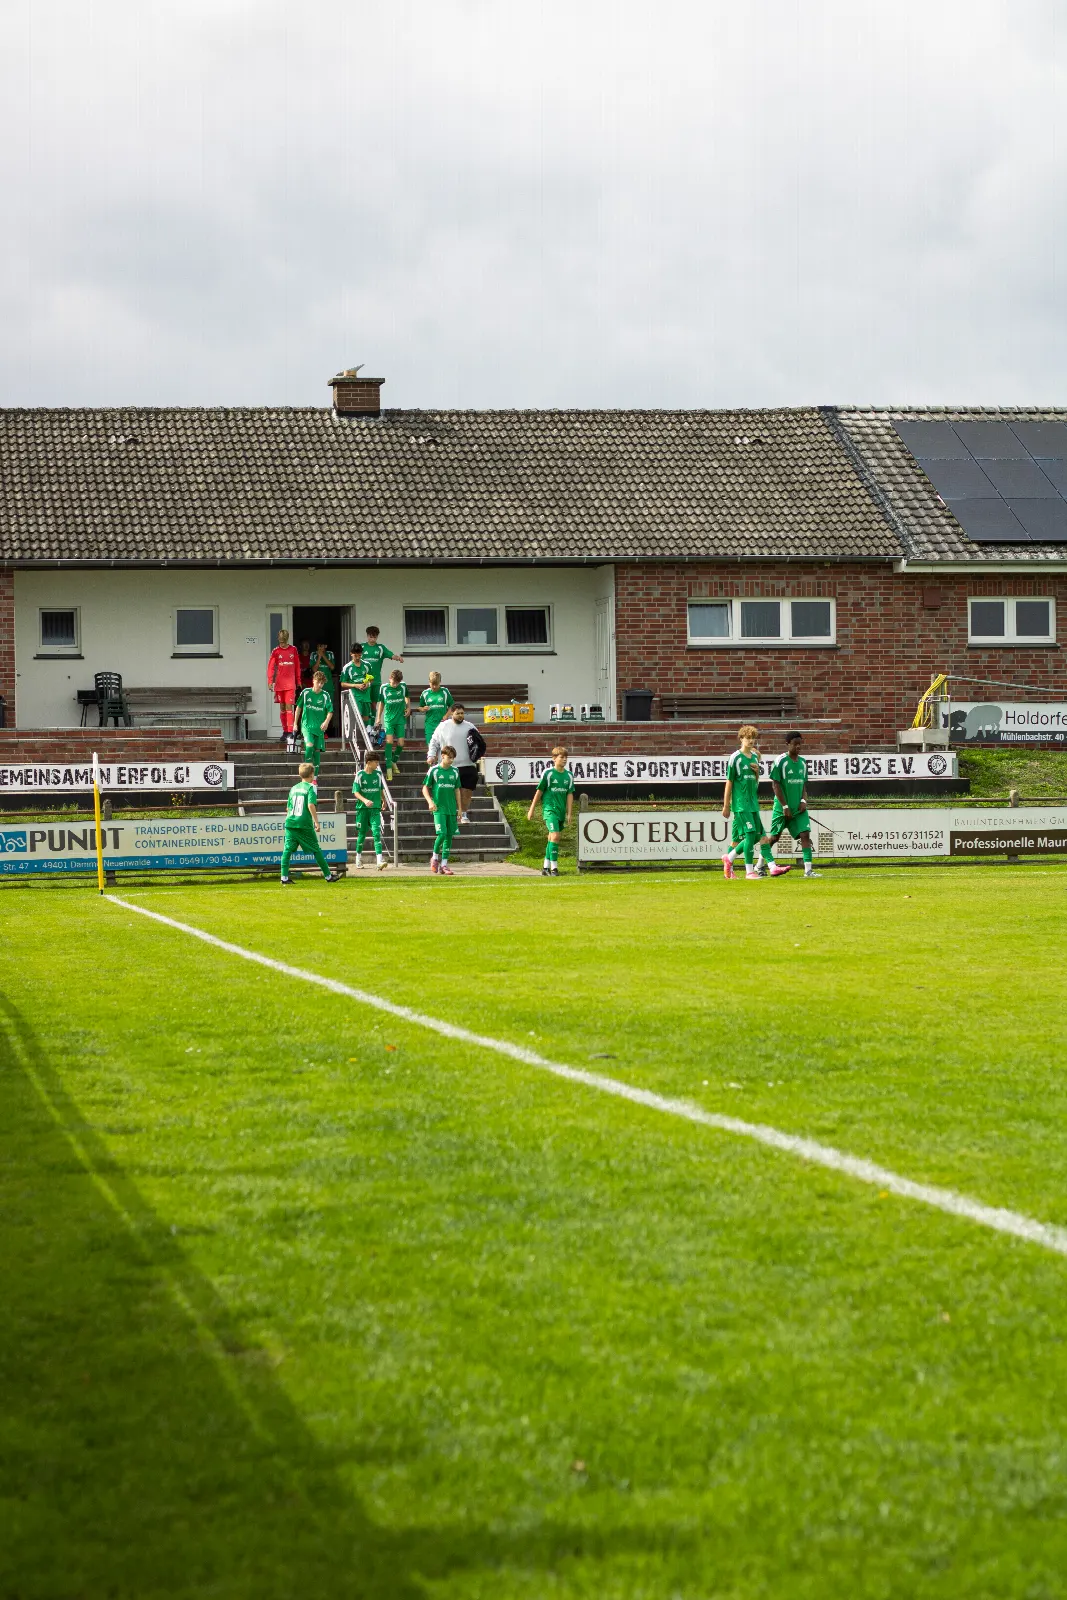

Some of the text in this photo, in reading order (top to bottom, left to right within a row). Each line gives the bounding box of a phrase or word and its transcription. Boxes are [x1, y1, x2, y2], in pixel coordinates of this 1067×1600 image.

[1005, 710, 1067, 725] Holdorfe
[1000, 732, 1065, 741] Mühlenbachstr. 40
[844, 757, 882, 775] 1925
[888, 756, 915, 775] E.V.
[117, 765, 190, 785] ERFOLG!
[135, 825, 198, 835] TRANSPORTE
[583, 818, 731, 844] OSTERHU
[847, 831, 863, 840] Tel.
[865, 831, 884, 840] +49
[901, 830, 944, 839] 67311521
[29, 827, 125, 852] PUNDT
[135, 838, 225, 849] CONTAINERDIENST
[836, 840, 944, 851] www.osterhues-bau.de
[954, 836, 1035, 849] Professionelle
[3, 863, 17, 871] Str.
[18, 862, 29, 870] 47
[42, 861, 68, 869] 49401
[164, 857, 177, 865] Tel.
